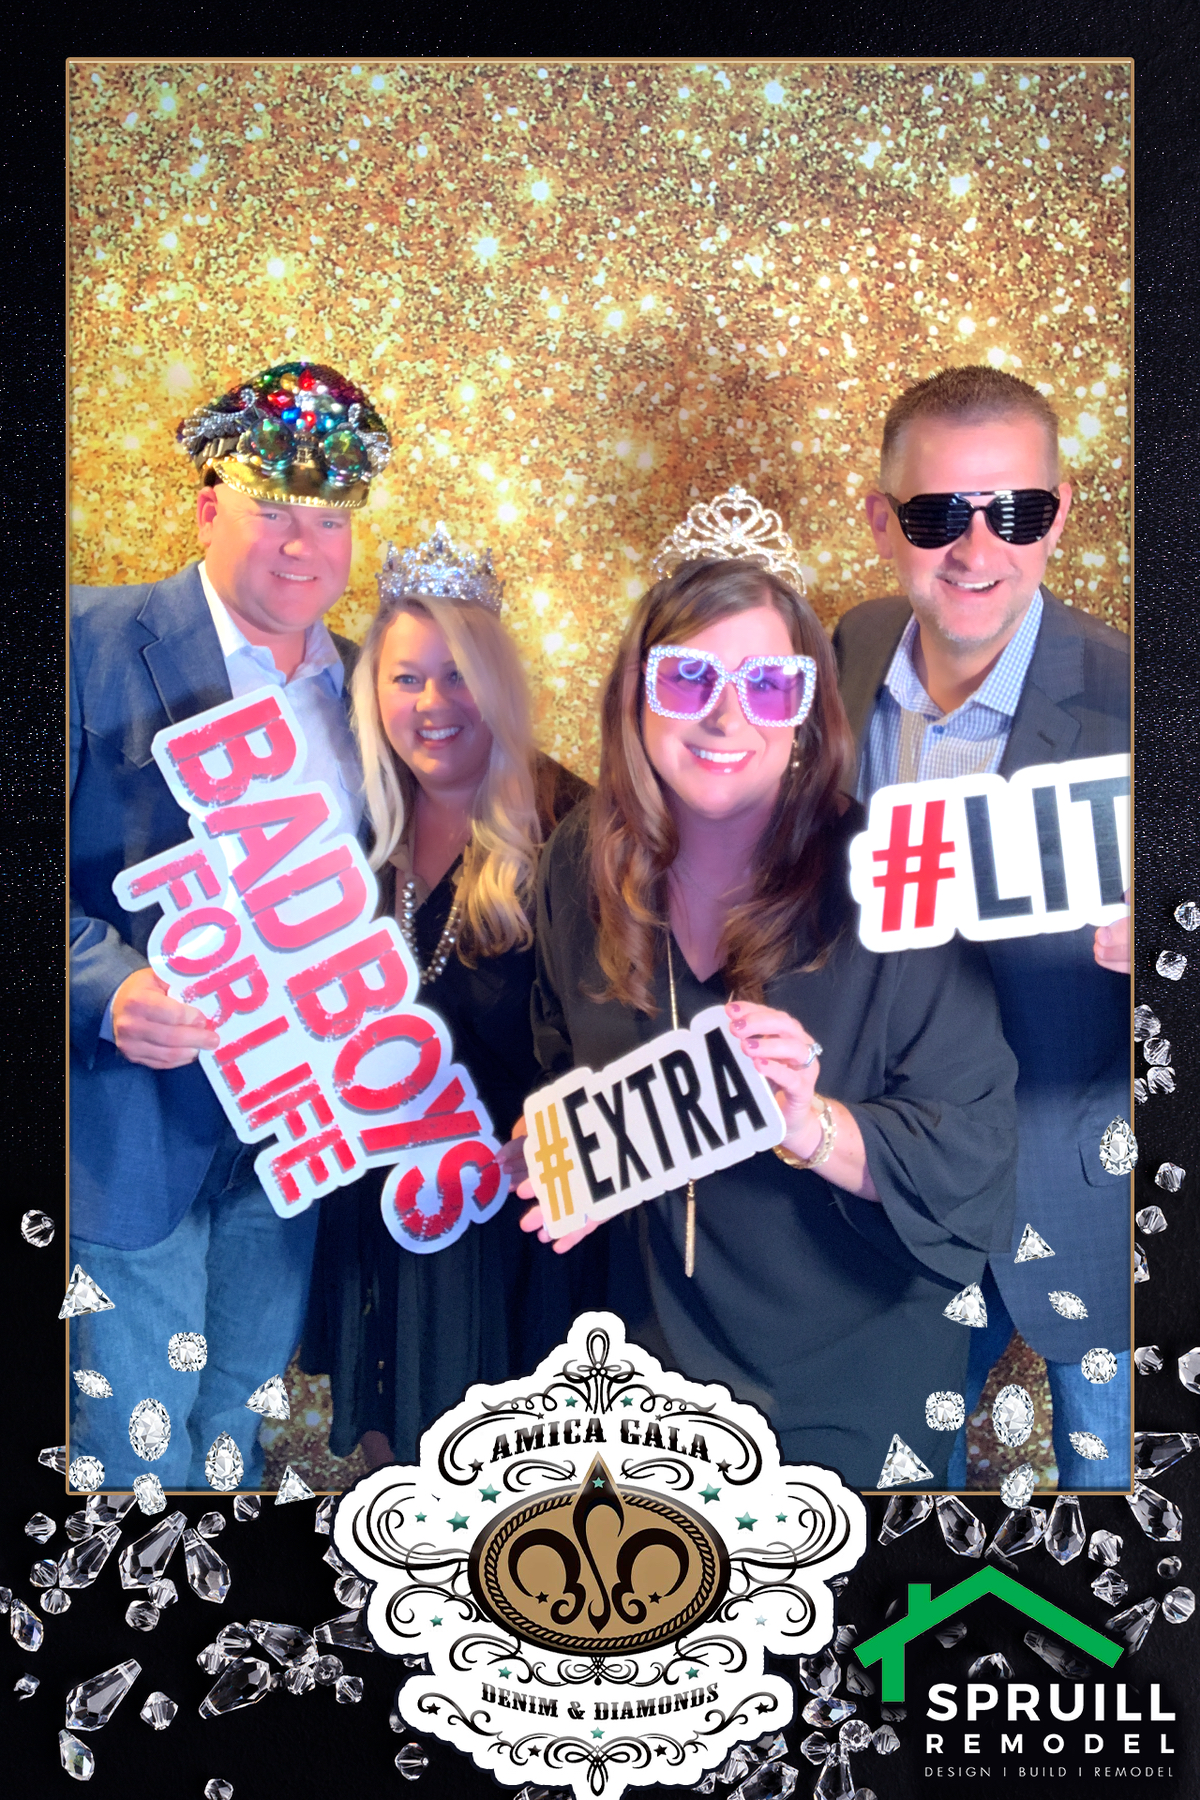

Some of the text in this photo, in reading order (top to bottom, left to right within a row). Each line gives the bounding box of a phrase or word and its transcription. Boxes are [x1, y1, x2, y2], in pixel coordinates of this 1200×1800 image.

[168, 696, 502, 1241] BAD BOYS
[872, 775, 1132, 933] #LIT
[128, 848, 357, 1205] FOR LIFE
[534, 1026, 768, 1222] #EXTRA
